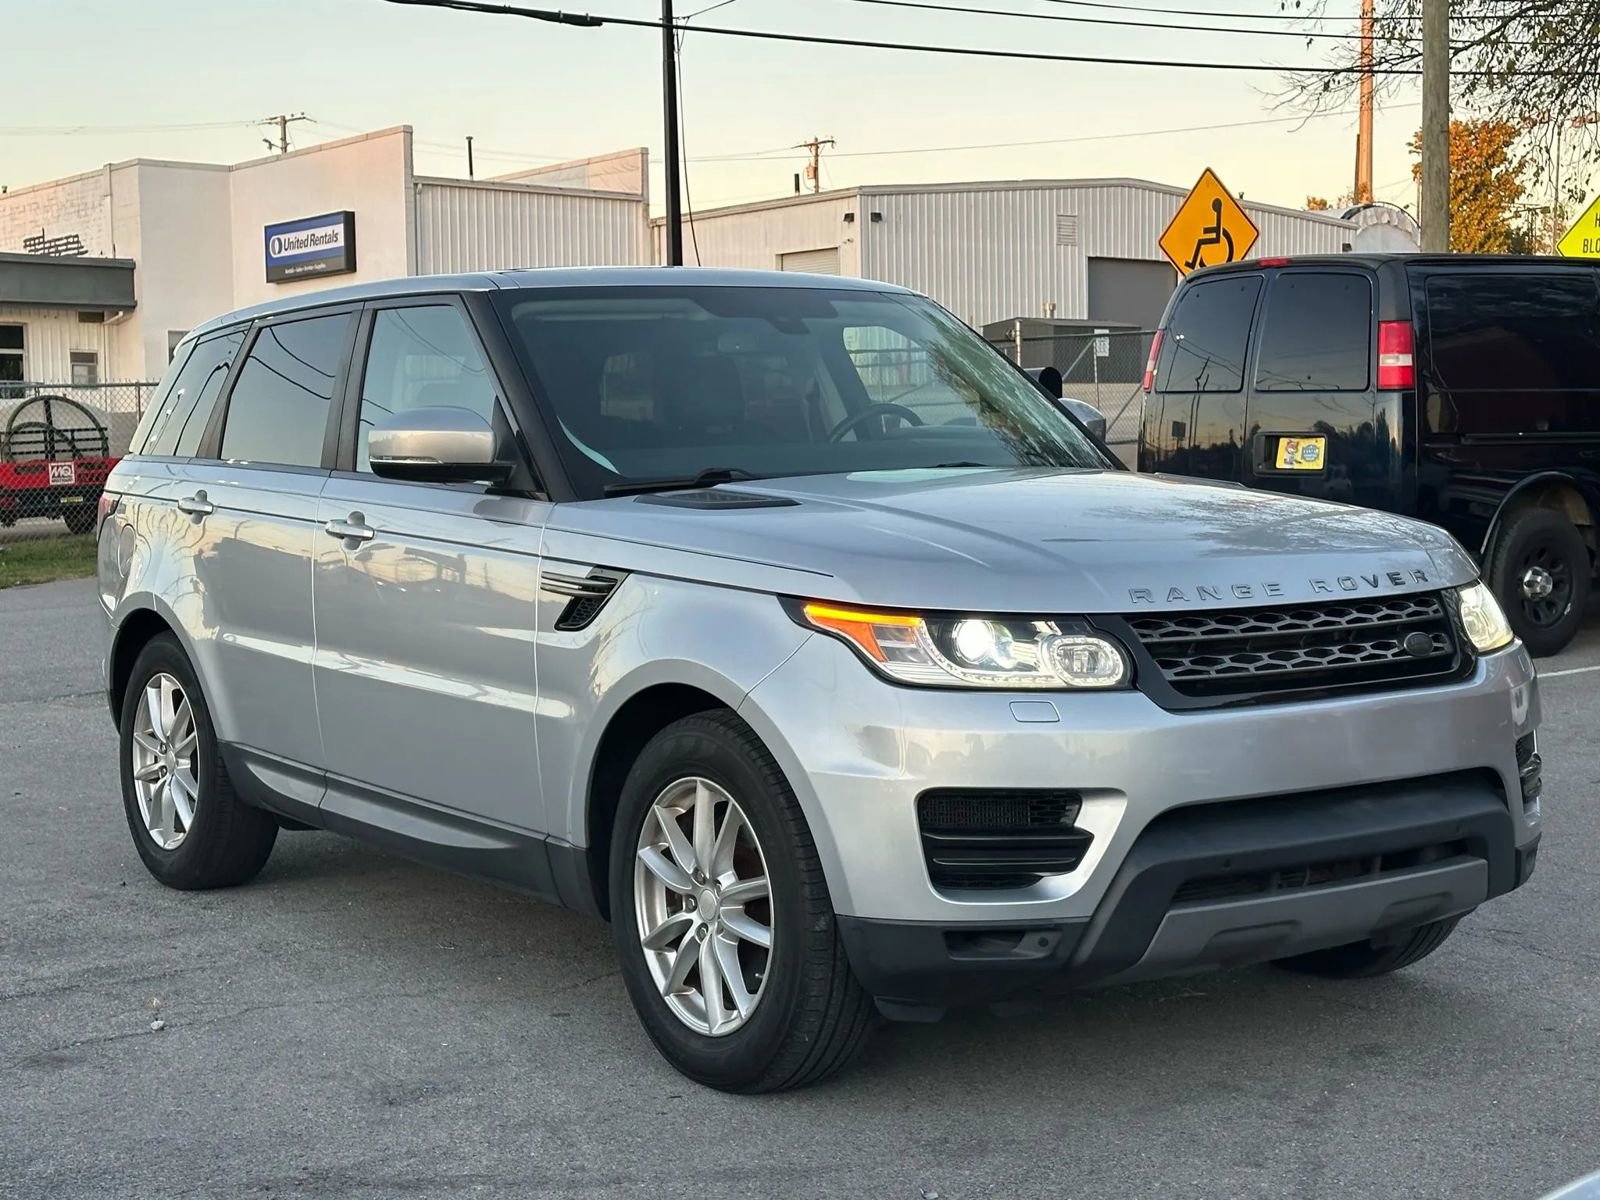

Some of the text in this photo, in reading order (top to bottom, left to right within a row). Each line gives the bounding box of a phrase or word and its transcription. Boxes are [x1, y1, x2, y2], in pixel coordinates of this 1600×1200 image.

[283, 230, 339, 252] United Rentals
[1128, 568, 1429, 604] RANGE ROVER
